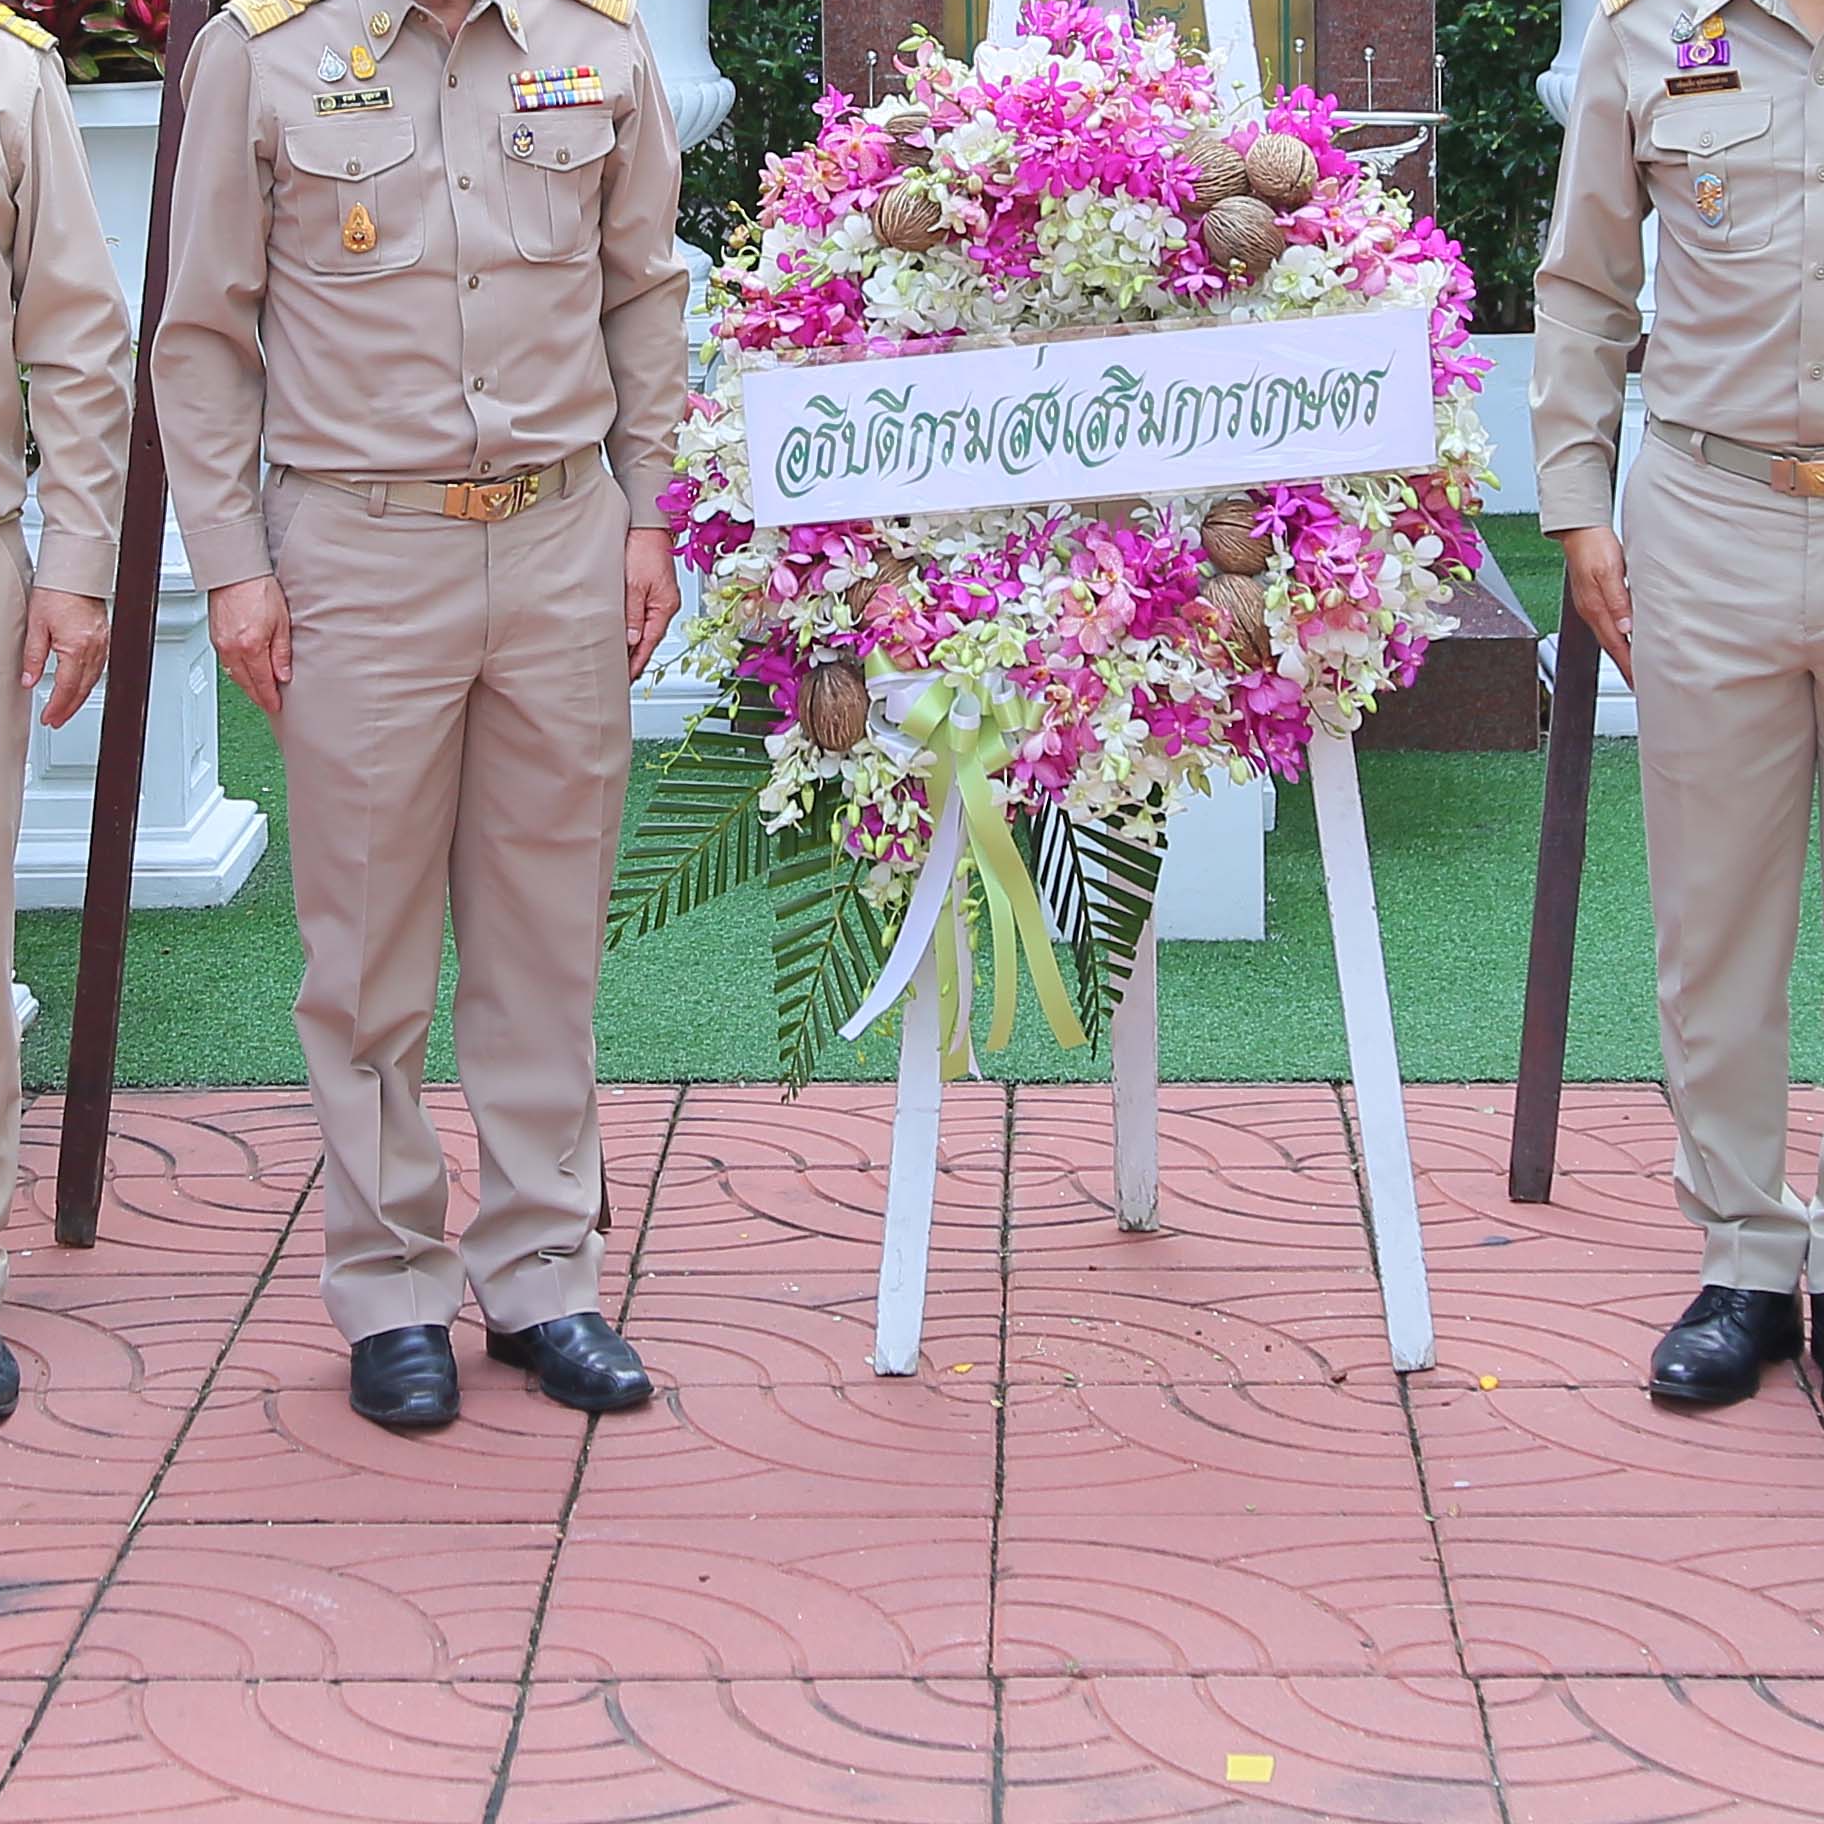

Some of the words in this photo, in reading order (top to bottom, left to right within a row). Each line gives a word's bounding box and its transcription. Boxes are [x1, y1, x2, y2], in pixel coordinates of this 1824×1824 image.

[775, 345, 1394, 498] อธิบดีกรมส่งเสริมการเกษตร
